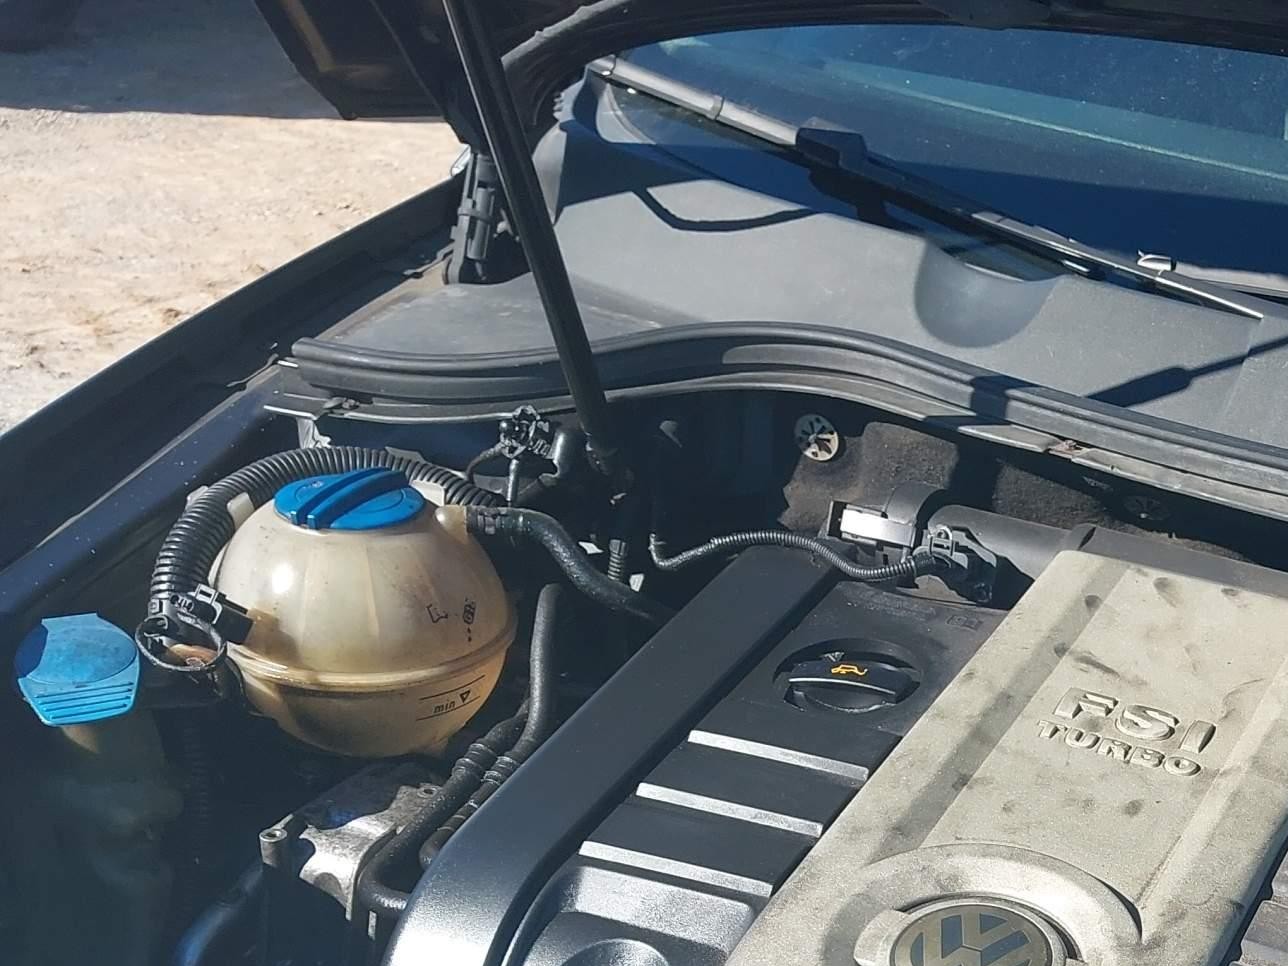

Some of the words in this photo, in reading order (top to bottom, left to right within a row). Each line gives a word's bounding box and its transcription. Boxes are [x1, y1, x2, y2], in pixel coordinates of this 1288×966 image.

[433, 699, 456, 714] min
[1054, 687, 1216, 754] FSI
[1037, 720, 1201, 777] TURBO
